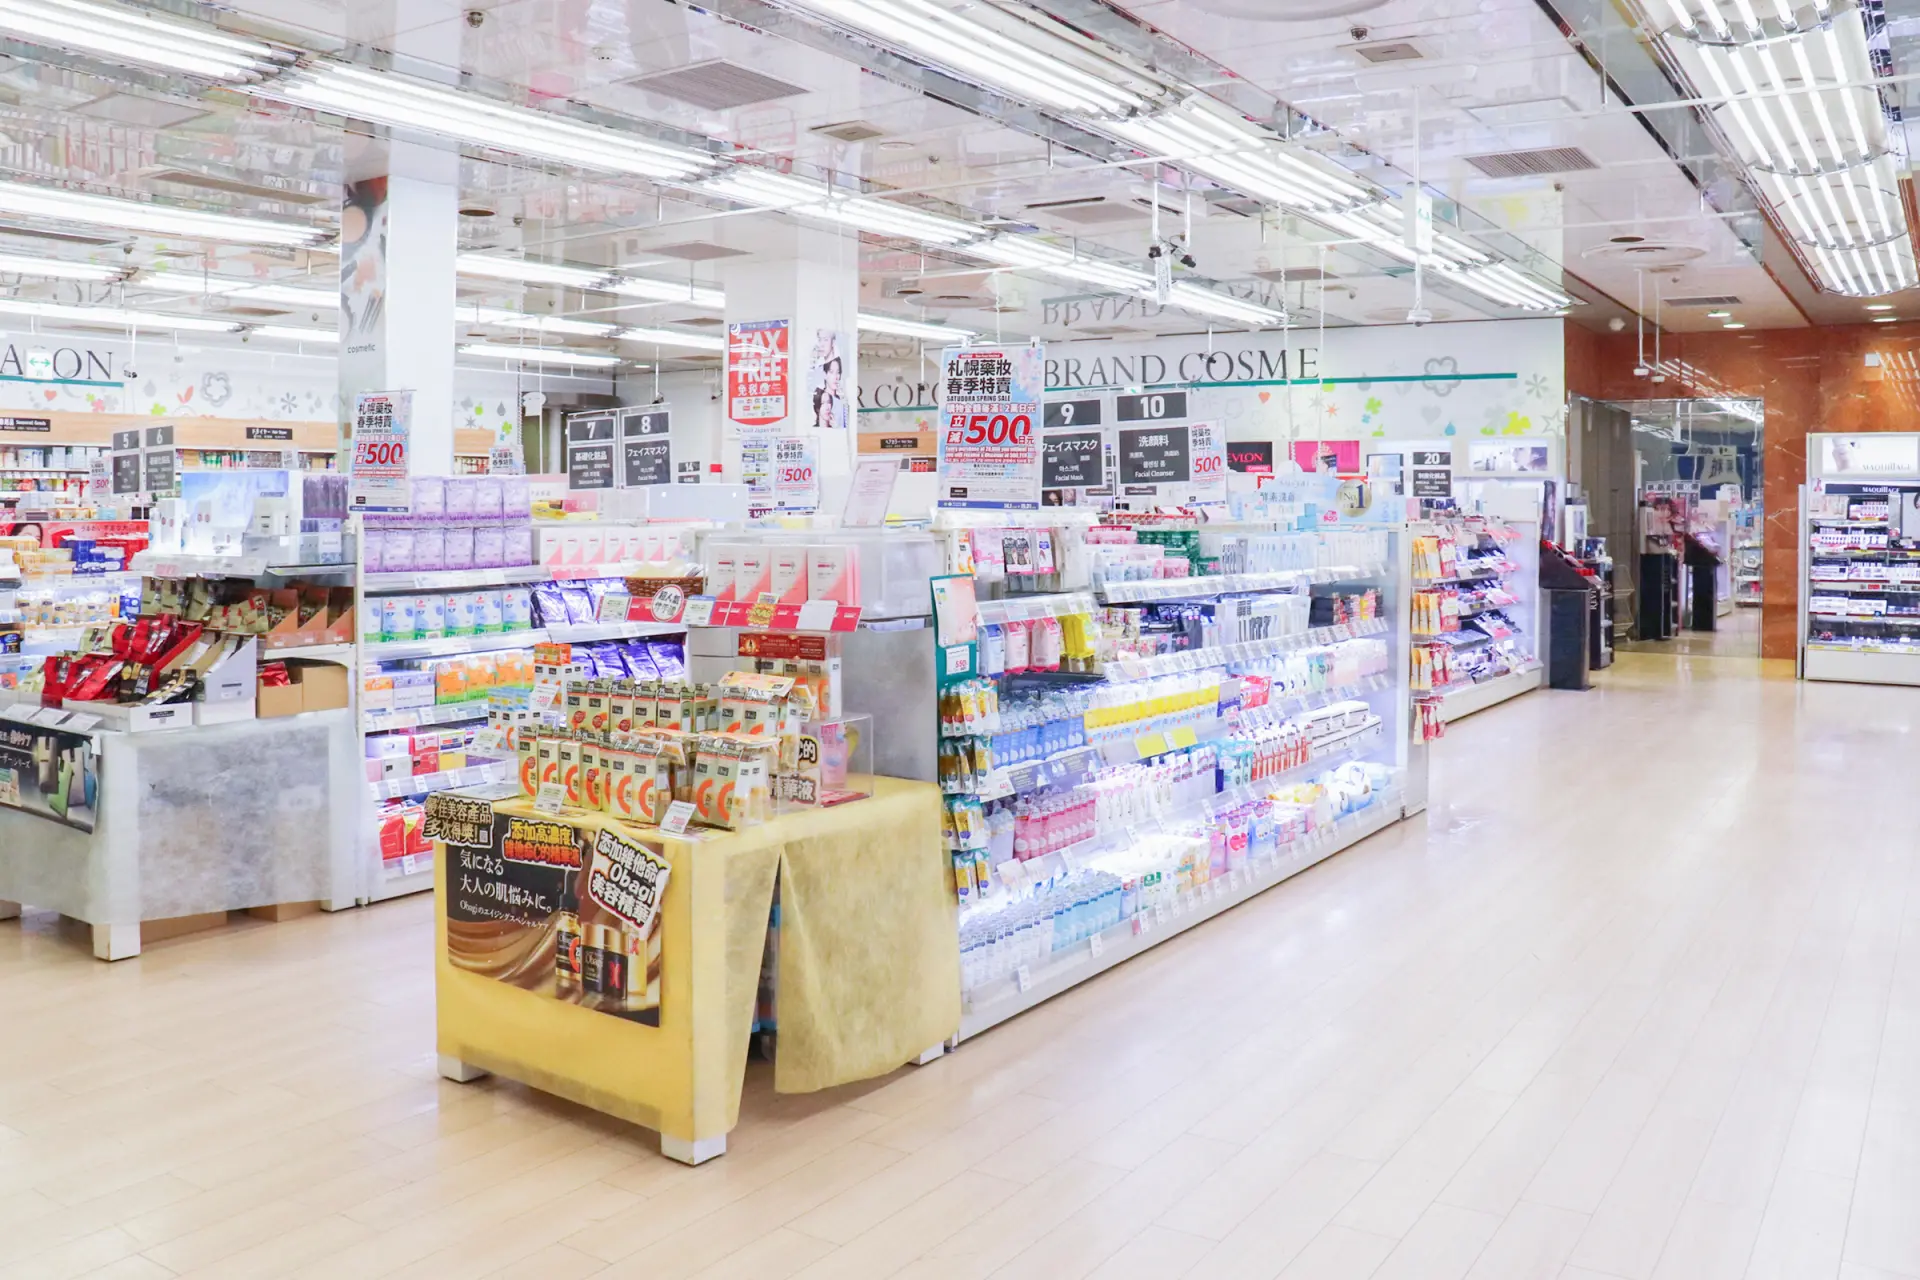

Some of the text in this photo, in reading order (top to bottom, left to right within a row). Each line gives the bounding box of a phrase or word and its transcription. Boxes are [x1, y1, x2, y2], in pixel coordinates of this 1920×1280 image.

[347, 344, 376, 354] cosmetic
[736, 330, 782, 358] TAX
[0, 344, 113, 380] AON
[737, 359, 782, 382] FREE
[947, 359, 1012, 376] 札幌藥妝
[1044, 348, 1319, 387] BRAND COSME
[947, 377, 1011, 395] 春季特賣
[1061, 403, 1074, 425] 9
[1140, 395, 1165, 418] 10
[357, 416, 392, 429] 春季特賣
[587, 422, 596, 439] 7
[641, 416, 651, 434] 8
[965, 414, 1031, 444] 500
[122, 433, 129, 449] 5
[156, 428, 164, 445] 6
[1138, 434, 1170, 448] 洗顔料
[365, 442, 404, 465] 500
[627, 445, 668, 457] フェイスマスク
[1424, 452, 1441, 465] 20
[784, 468, 812, 482] 500
[1194, 456, 1221, 473] 500
[511, 821, 571, 846] 添加高濃度
[460, 849, 504, 876] 気になる
[597, 830, 659, 883] 添加維他命
[460, 873, 552, 913] 大人の肌悩みに。
[609, 863, 656, 905] Obagi
[592, 872, 651, 924] 美容精華
[460, 899, 549, 930] Obagiのエイジングスペシャルケア
